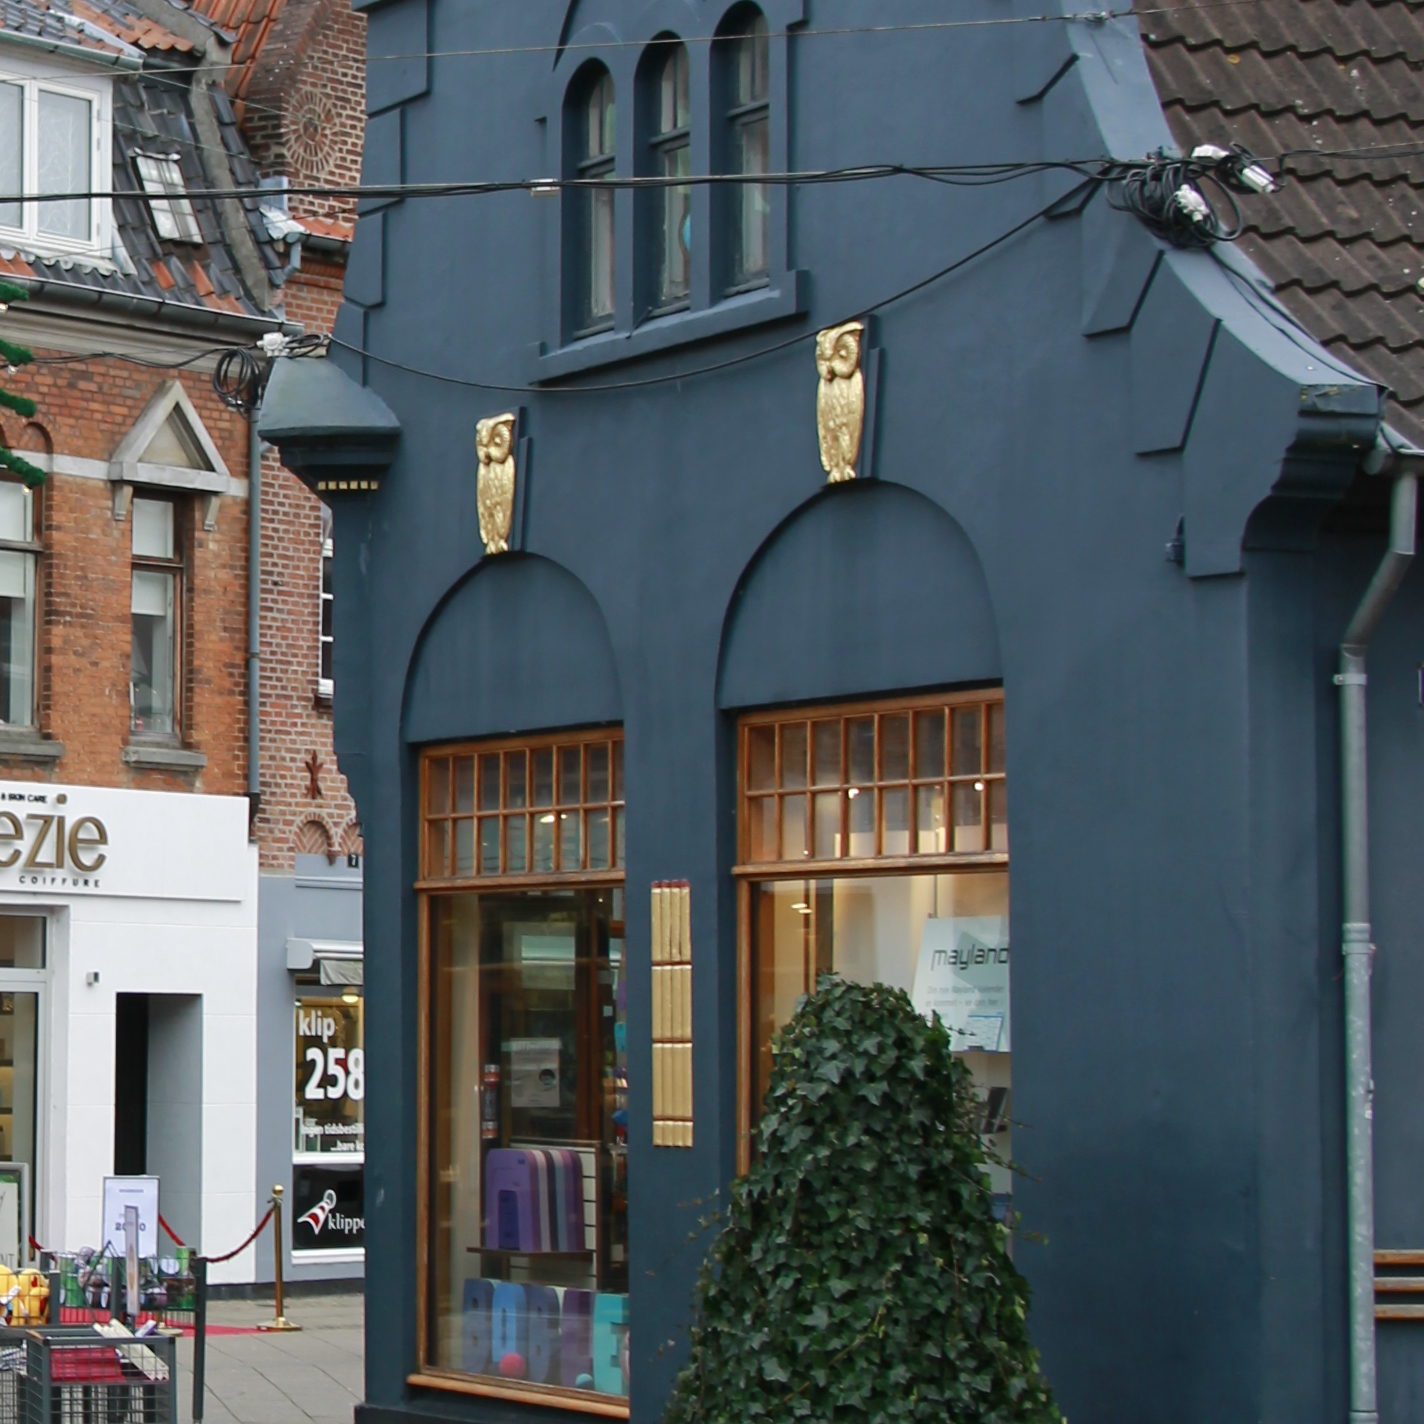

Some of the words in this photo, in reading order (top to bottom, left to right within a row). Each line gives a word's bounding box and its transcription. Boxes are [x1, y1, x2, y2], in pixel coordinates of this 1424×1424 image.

[27, 794, 48, 803] CARE
[18, 876, 101, 888] COIFFURE
[298, 1010, 336, 1043] klip
[304, 1046, 364, 1101] 258
